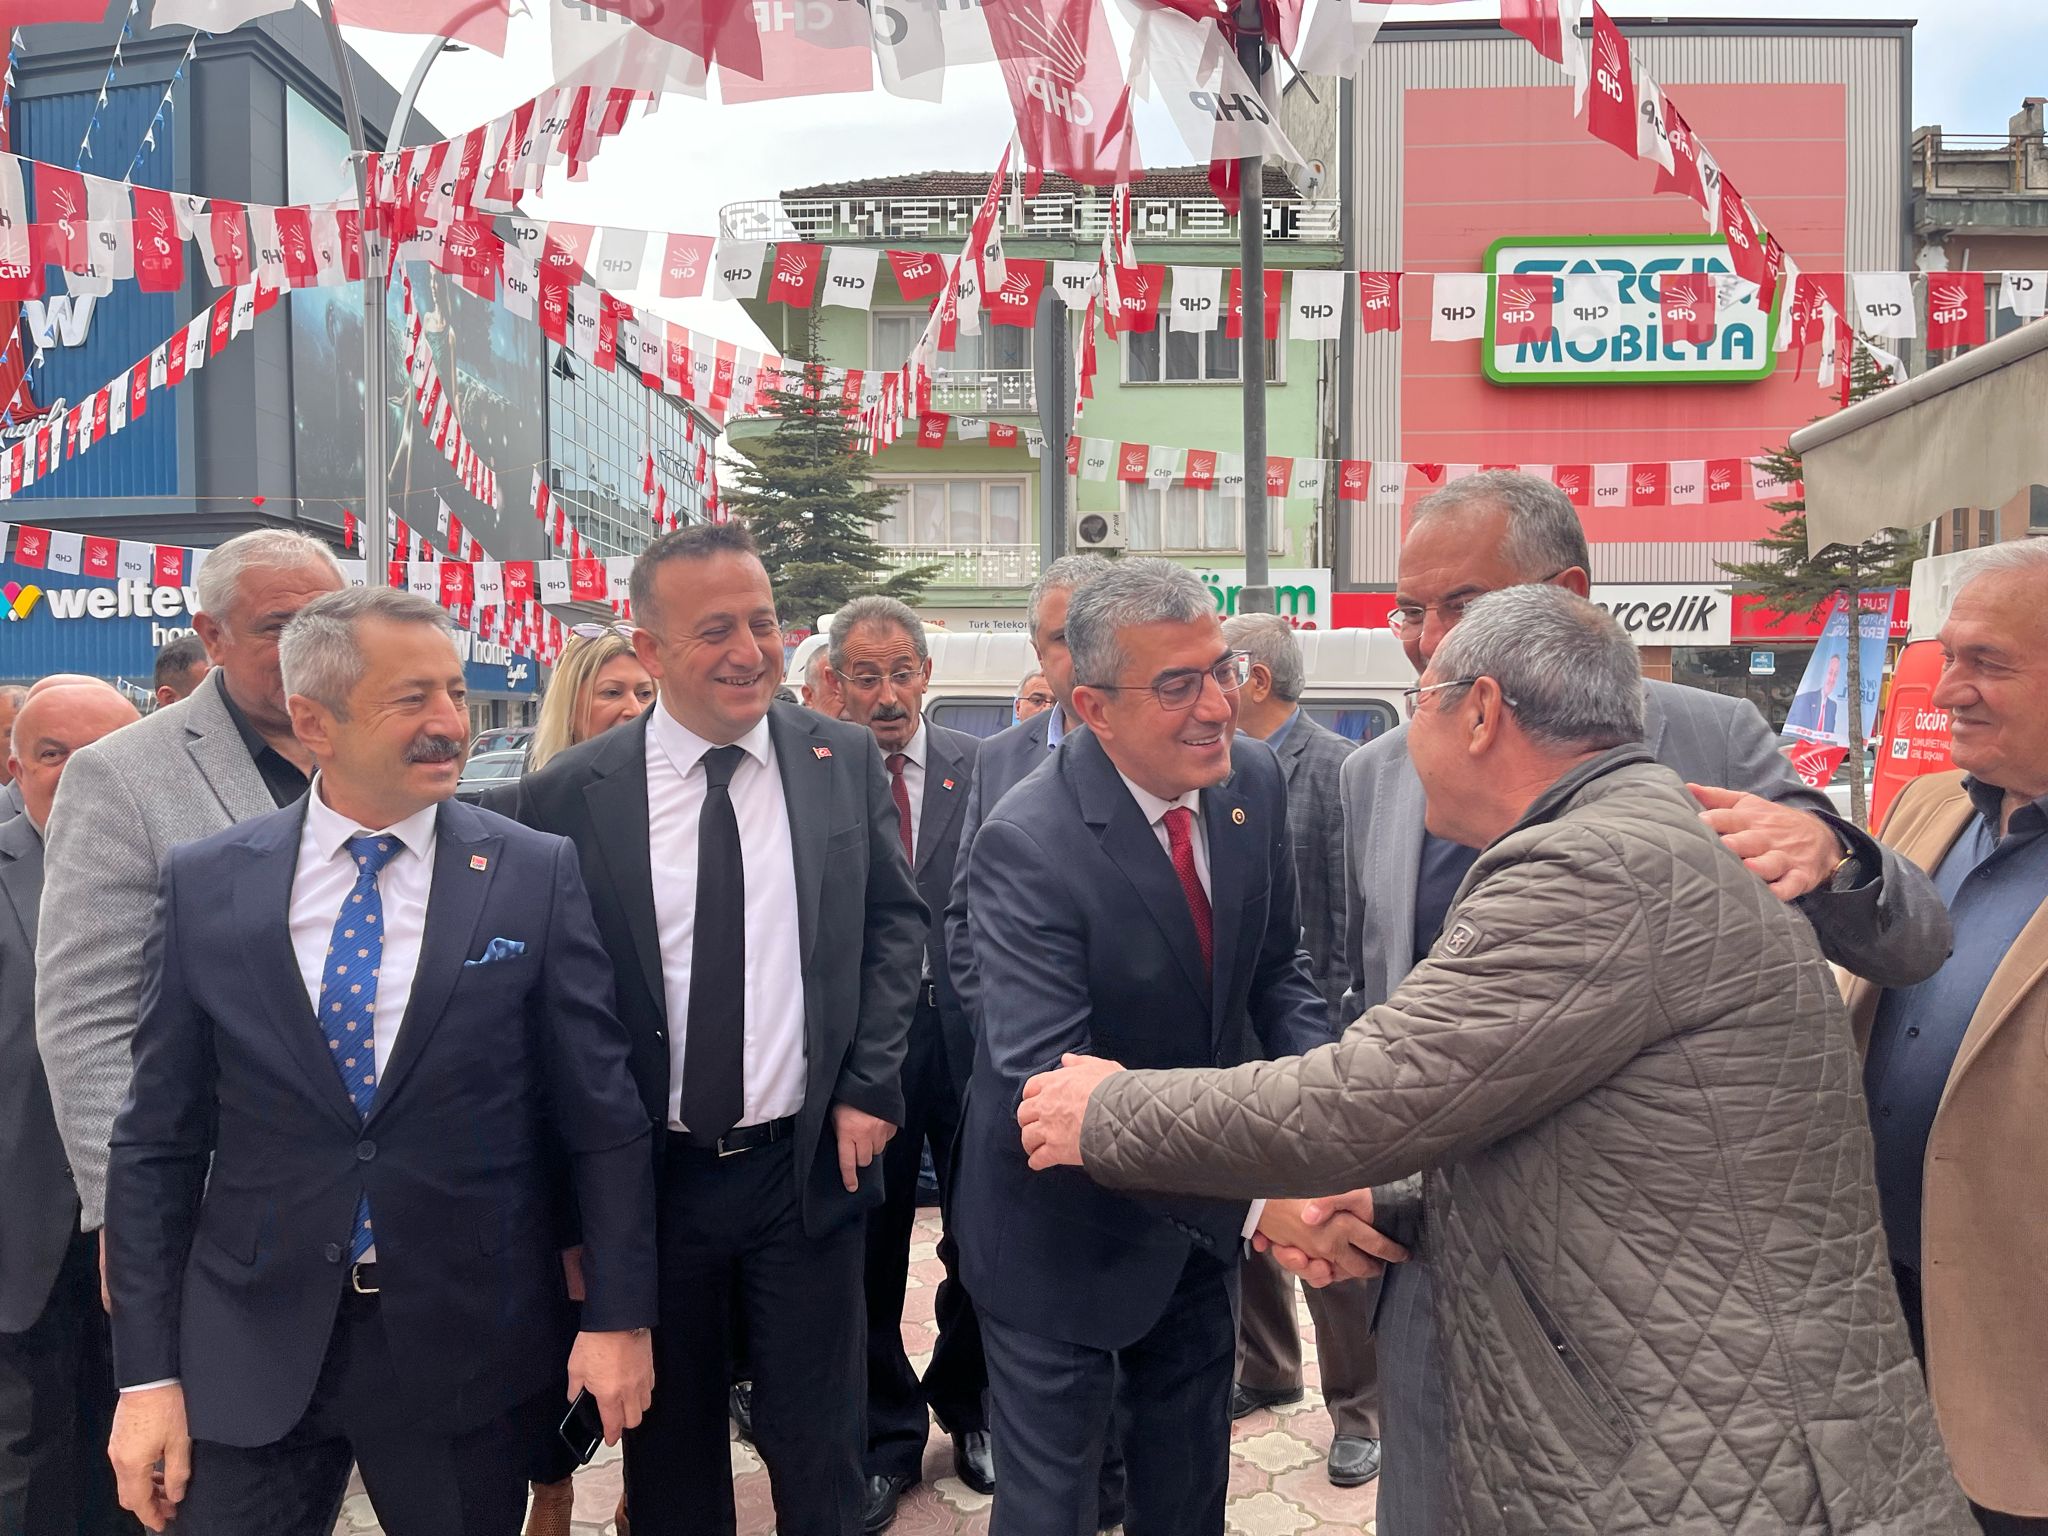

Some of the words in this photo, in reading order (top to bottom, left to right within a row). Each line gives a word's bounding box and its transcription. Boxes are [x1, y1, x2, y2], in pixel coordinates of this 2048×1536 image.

[0, 264, 31, 279] CHP
[508, 277, 528, 294] CHP
[544, 300, 562, 314] CHP
[577, 313, 595, 329] CHP
[642, 343, 658, 355] CHP
[170, 357, 183, 370] CHP
[694, 361, 708, 373] CHP
[738, 375, 753, 387] CHP
[866, 395, 878, 404] CHP
[924, 431, 942, 440] CHP
[996, 429, 1014, 438] CHP
[1087, 458, 1105, 468] CHP
[1125, 464, 1144, 473] CHP
[1153, 468, 1172, 478] CHP
[1192, 471, 1210, 480] CHP
[1224, 476, 1243, 484] CHP
[1267, 478, 1285, 486] CHP
[1299, 479, 1318, 489] CHP
[1344, 480, 1362, 488] CHP
[1710, 481, 1731, 491] CHP
[1756, 478, 1777, 488] CHP
[1380, 485, 1399, 493] CHP
[1597, 488, 1618, 497] CHP
[1635, 486, 1655, 495] CHP
[1673, 484, 1695, 494] CHP
[968, 619, 990, 629] Türk
[1915, 708, 1948, 732] ÖZGÜR
[1894, 741, 1908, 756] CHP
